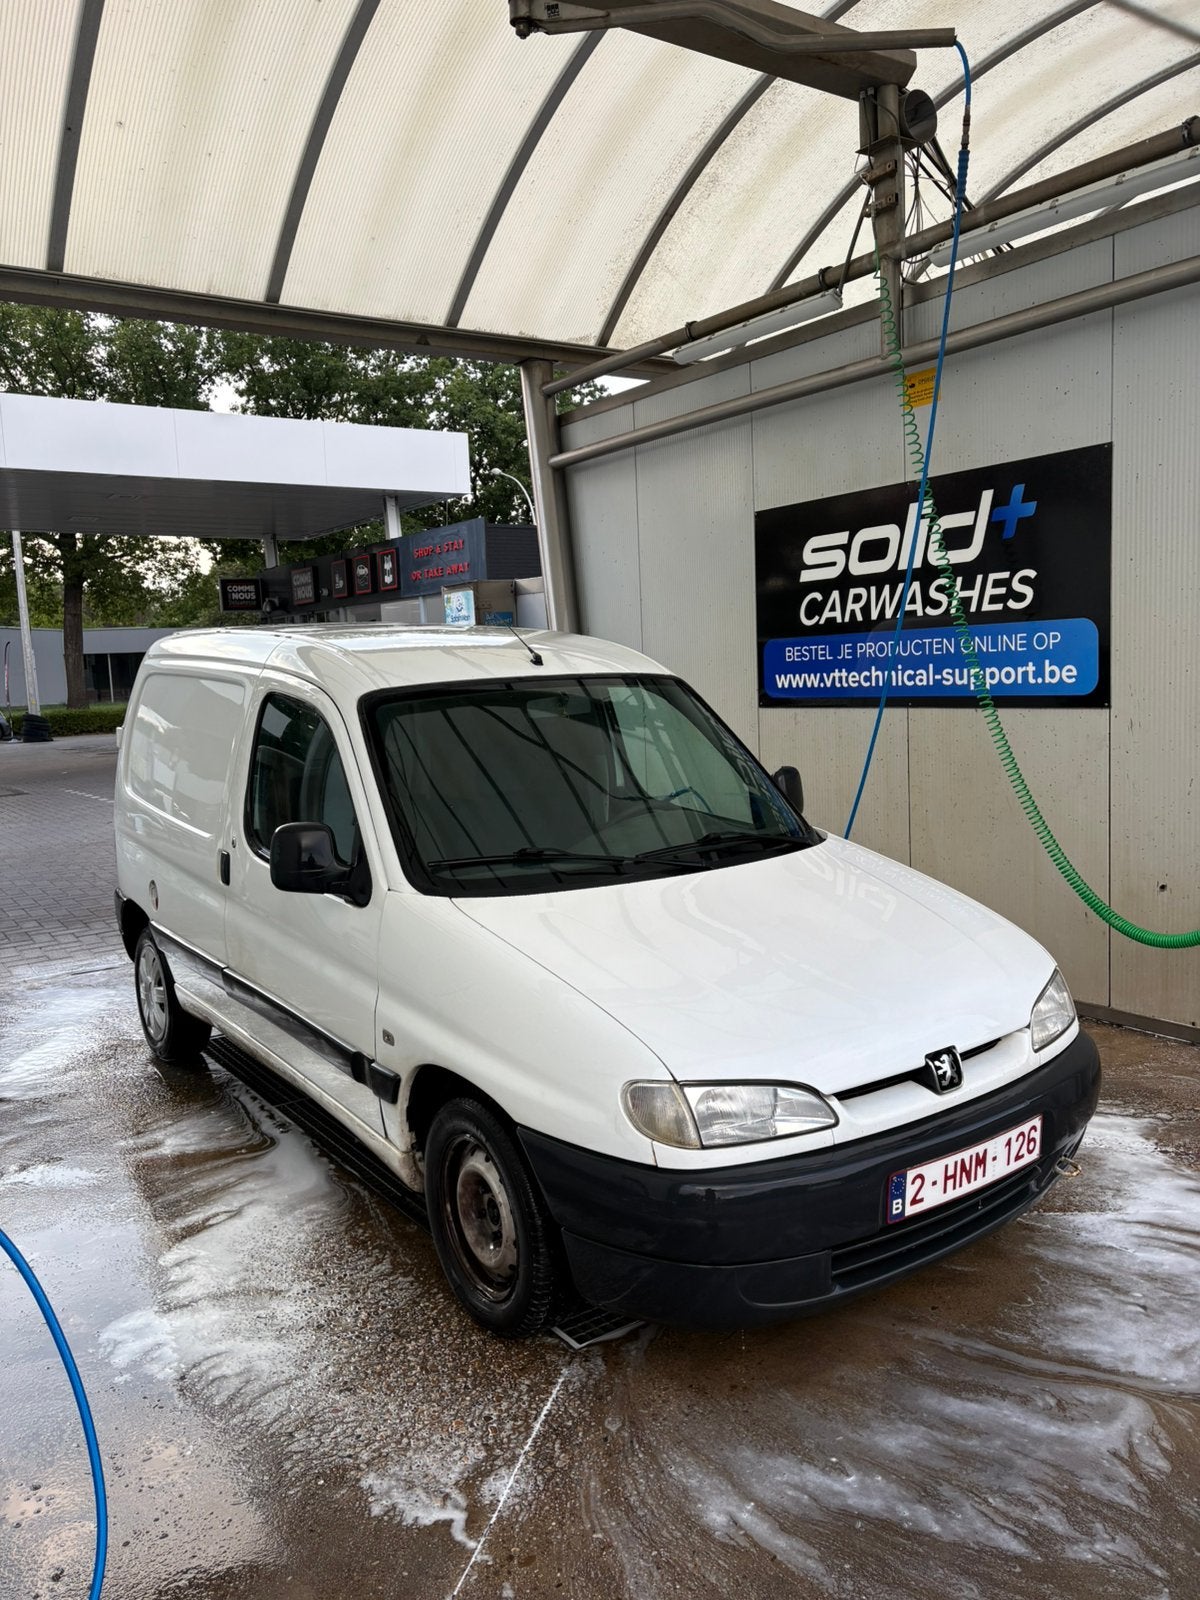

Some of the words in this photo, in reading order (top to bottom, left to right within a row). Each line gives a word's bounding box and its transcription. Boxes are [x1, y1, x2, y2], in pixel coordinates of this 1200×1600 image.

[413, 545, 433, 559] SHOP
[443, 539, 465, 553] STAY
[293, 571, 312, 586] COMME
[411, 570, 422, 581] OR
[424, 566, 444, 578] TAKE
[446, 561, 470, 575] AWAY
[226, 584, 256, 593] COMME
[231, 592, 257, 601] NOUS
[297, 585, 313, 600] NOUS
[799, 568, 1038, 626] CARWASHES
[785, 645, 834, 662] BESTEL
[836, 643, 853, 660] JE
[857, 637, 955, 659] PRODUCTEN
[960, 633, 1028, 654] ONLINE
[1033, 631, 1061, 651] OP
[775, 659, 1078, 691] www.vttechnical-support.be
[892, 1198, 903, 1215] B
